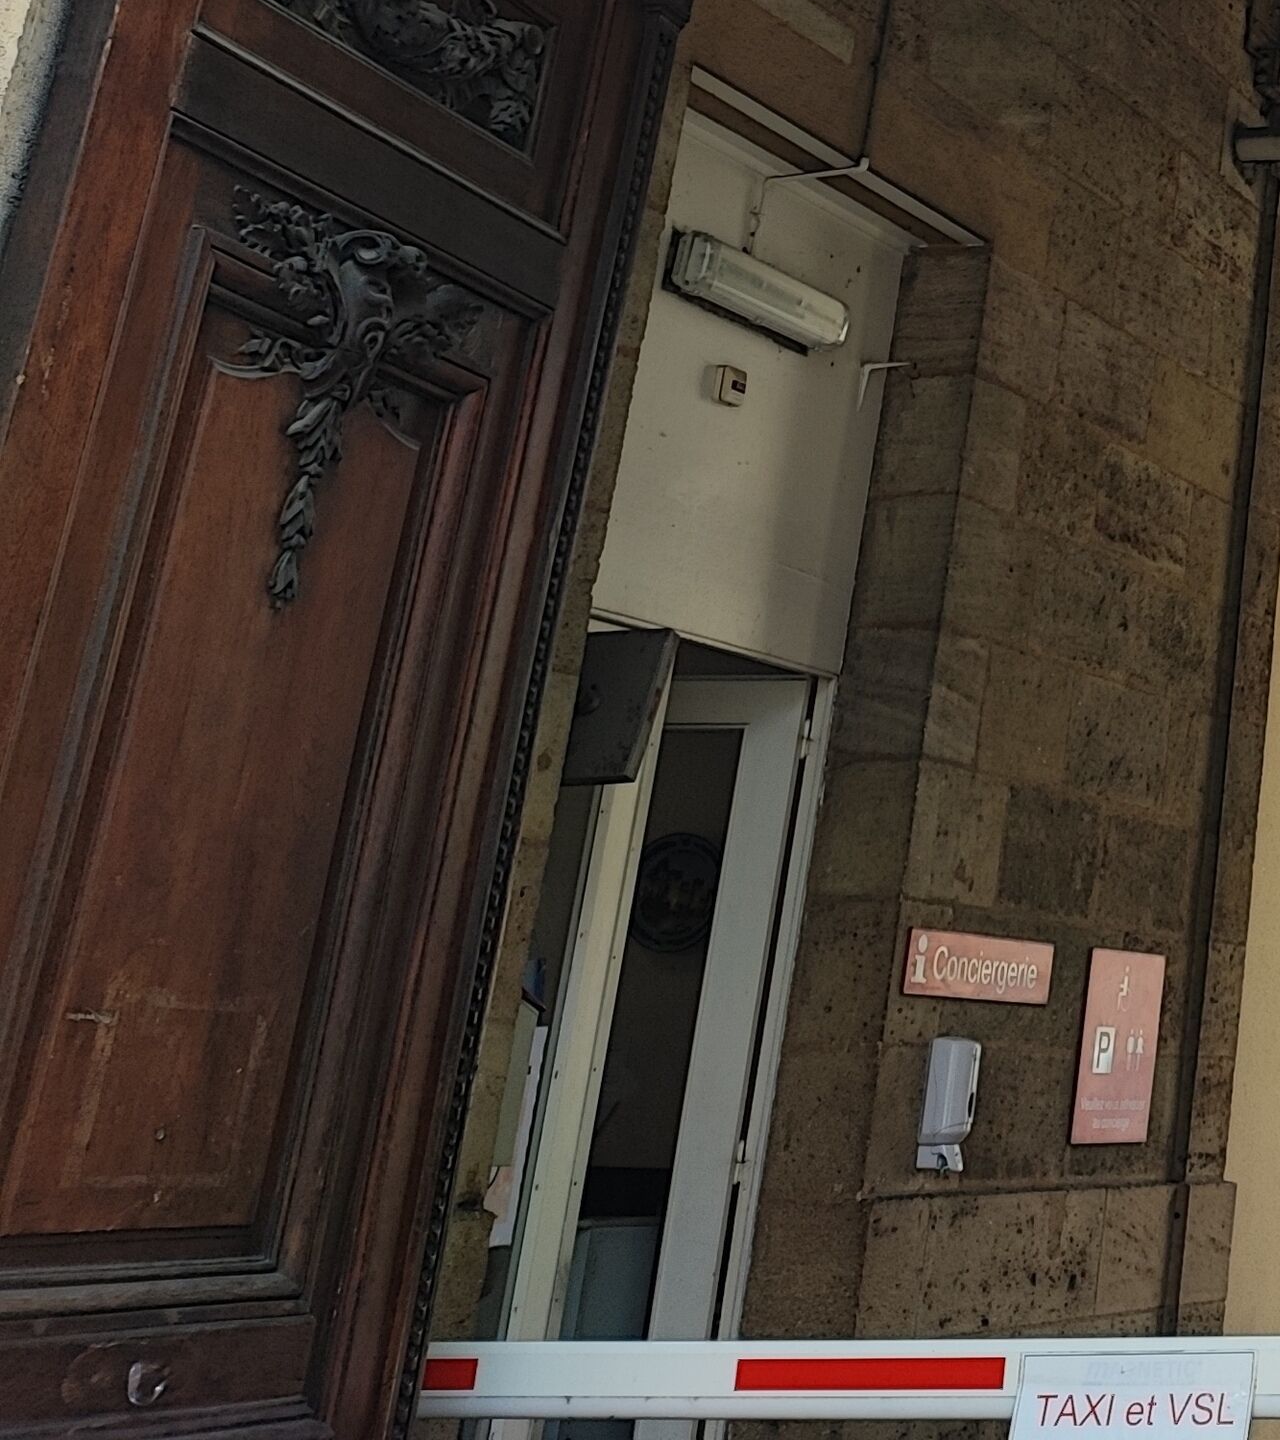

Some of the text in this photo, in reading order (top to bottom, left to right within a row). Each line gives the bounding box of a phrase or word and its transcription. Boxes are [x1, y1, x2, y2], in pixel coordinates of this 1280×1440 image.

[932, 945, 1039, 994] Conciergerie
[1036, 1392, 1235, 1427] TAXI et VSL
